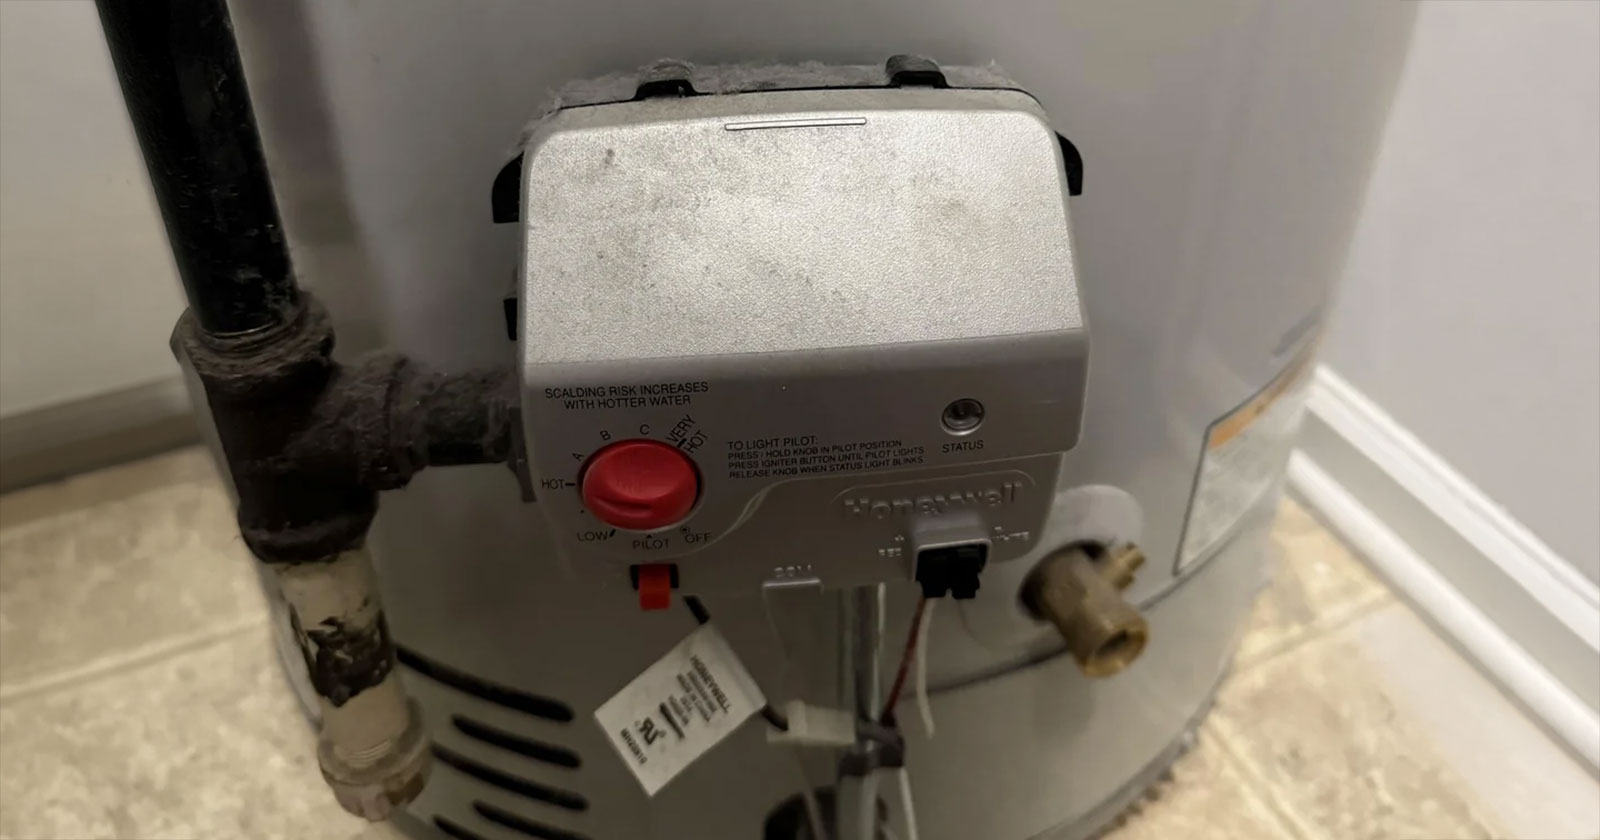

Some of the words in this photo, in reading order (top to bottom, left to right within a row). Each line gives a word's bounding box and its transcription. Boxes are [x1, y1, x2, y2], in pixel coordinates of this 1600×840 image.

[545, 386, 606, 399] SCALDING
[609, 385, 637, 396] RISK
[640, 382, 709, 394] INCREASES
[564, 400, 595, 410] WITH
[598, 397, 646, 409] HOTTER
[650, 395, 691, 406] WATER
[600, 430, 611, 440] B
[639, 424, 650, 435] C
[666, 414, 696, 443] VERY
[684, 430, 708, 453] HOT
[728, 441, 743, 451] TO
[746, 438, 779, 450] LIGHT
[942, 439, 984, 453] STATUS
[572, 452, 584, 462] A
[728, 452, 758, 461] PRESS
[766, 449, 790, 458] HOLD
[793, 447, 818, 456] KNOB
[832, 444, 857, 453] PILOT
[859, 440, 902, 450] POSITION
[728, 461, 759, 470] PRESS
[761, 459, 797, 468] IGNITER
[800, 455, 835, 465] BUTTON
[838, 453, 863, 462] UNTIL
[865, 450, 890, 460] PILOT
[893, 446, 924, 457] LIGHTS
[729, 470, 770, 479] RELEASE
[772, 468, 797, 476] KNOB
[800, 465, 827, 474] WHEN
[829, 462, 863, 472] STATUS
[865, 460, 890, 470] LIGHT
[893, 456, 924, 467] BLINKS
[542, 479, 564, 490] HOT
[577, 531, 608, 542] LOW
[684, 532, 711, 544] OFF
[632, 539, 669, 550] PILOT
[690, 655, 731, 714] HONEYWELL
